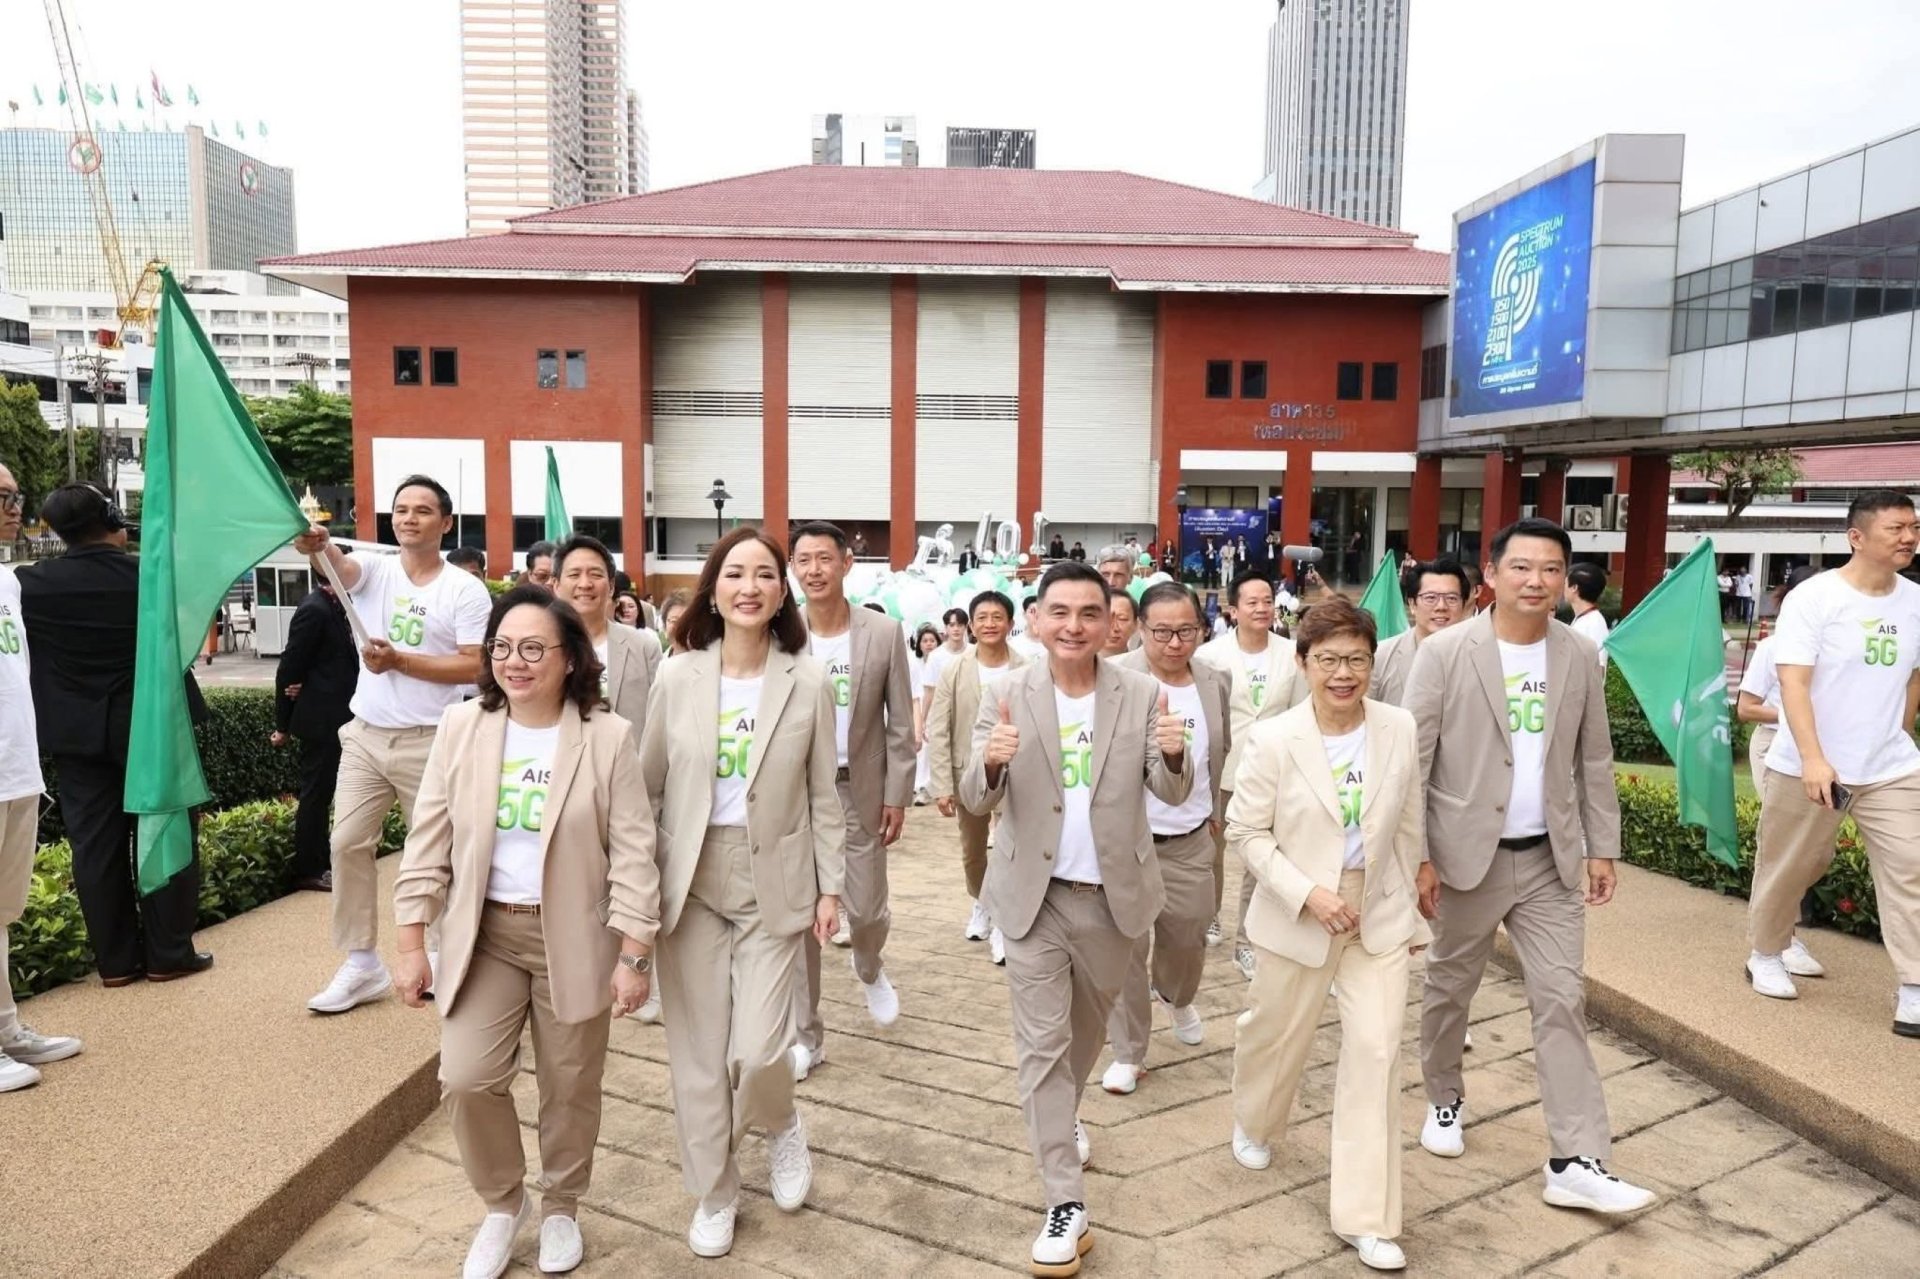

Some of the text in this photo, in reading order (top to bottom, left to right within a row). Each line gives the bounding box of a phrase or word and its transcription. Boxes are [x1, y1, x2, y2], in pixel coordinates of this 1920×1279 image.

[1520, 214, 1564, 243] SPECTRUM
[1518, 233, 1553, 258] AUCTION
[1517, 254, 1537, 273] 2025
[408, 603, 427, 617] AIS
[388, 612, 424, 647] 5G
[1878, 624, 1898, 635] AIS
[1864, 635, 1898, 667] 5G
[835, 676, 850, 707] G
[736, 718, 755, 732] AI
[1505, 697, 1545, 733] 5G
[496, 785, 546, 832] 5G
